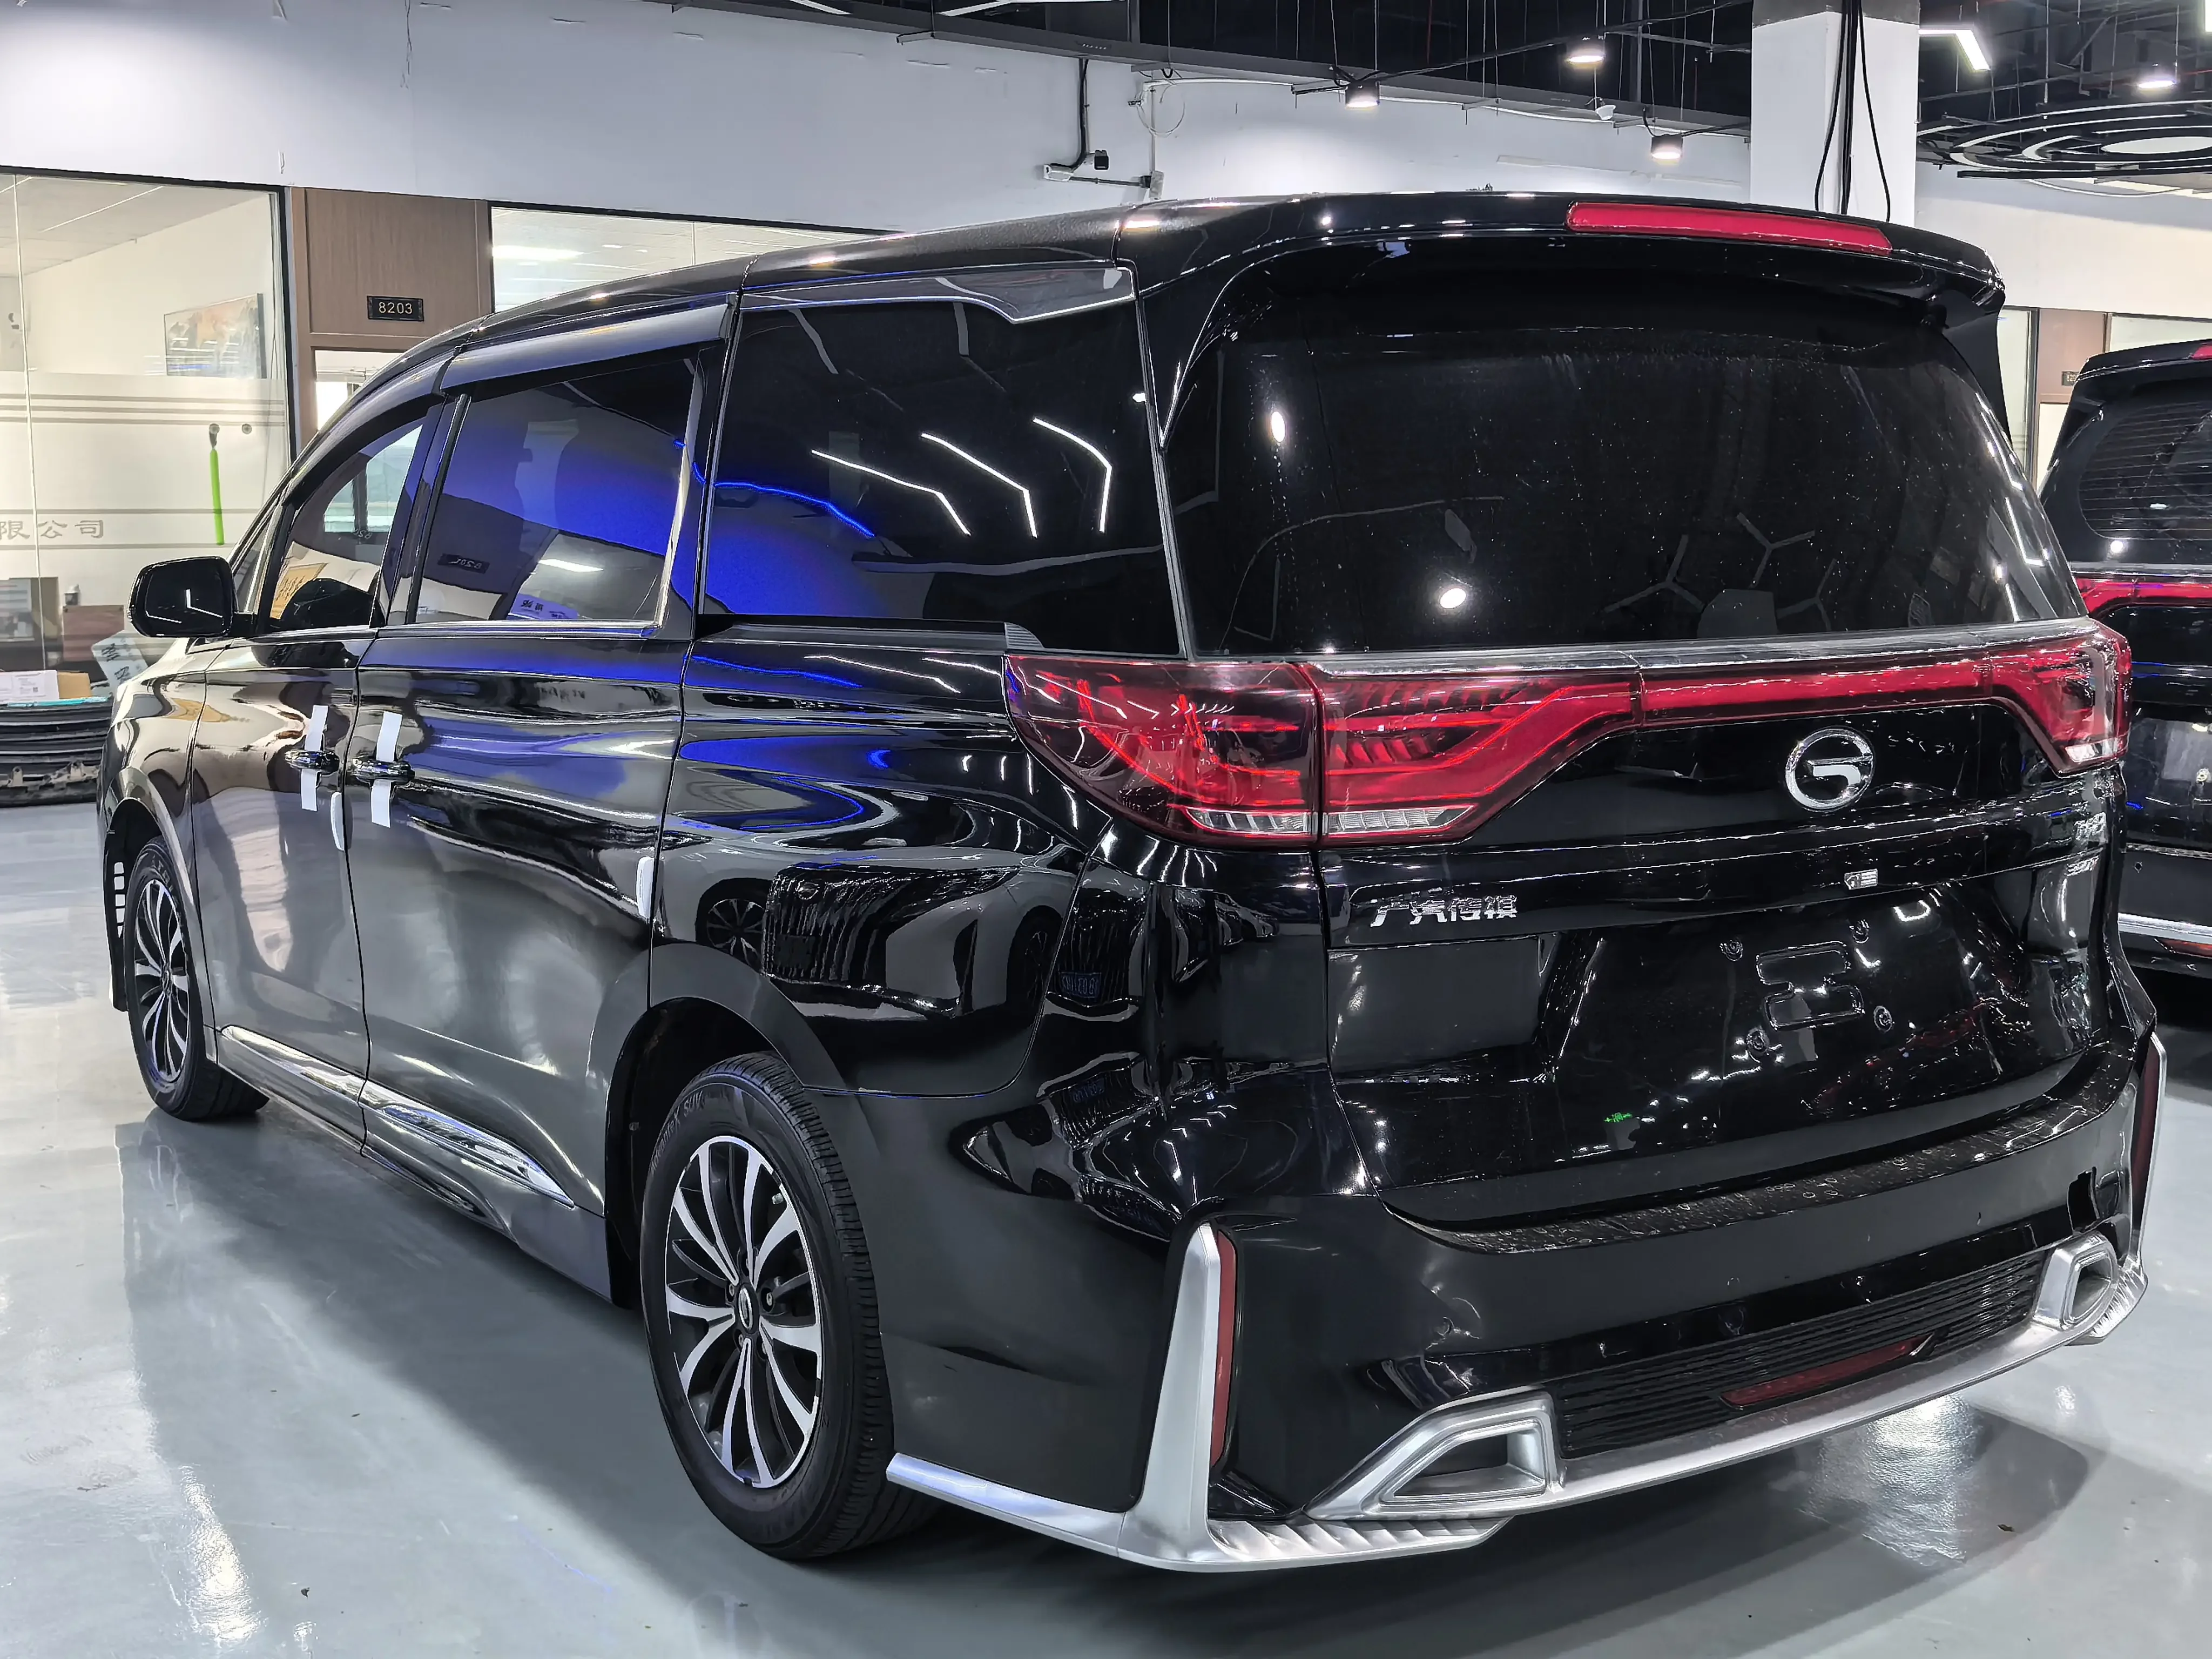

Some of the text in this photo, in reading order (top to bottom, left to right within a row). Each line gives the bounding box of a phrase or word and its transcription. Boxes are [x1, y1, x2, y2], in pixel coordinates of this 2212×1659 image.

[379, 301, 413, 314] 8203
[0, 520, 104, 539] 限公司
